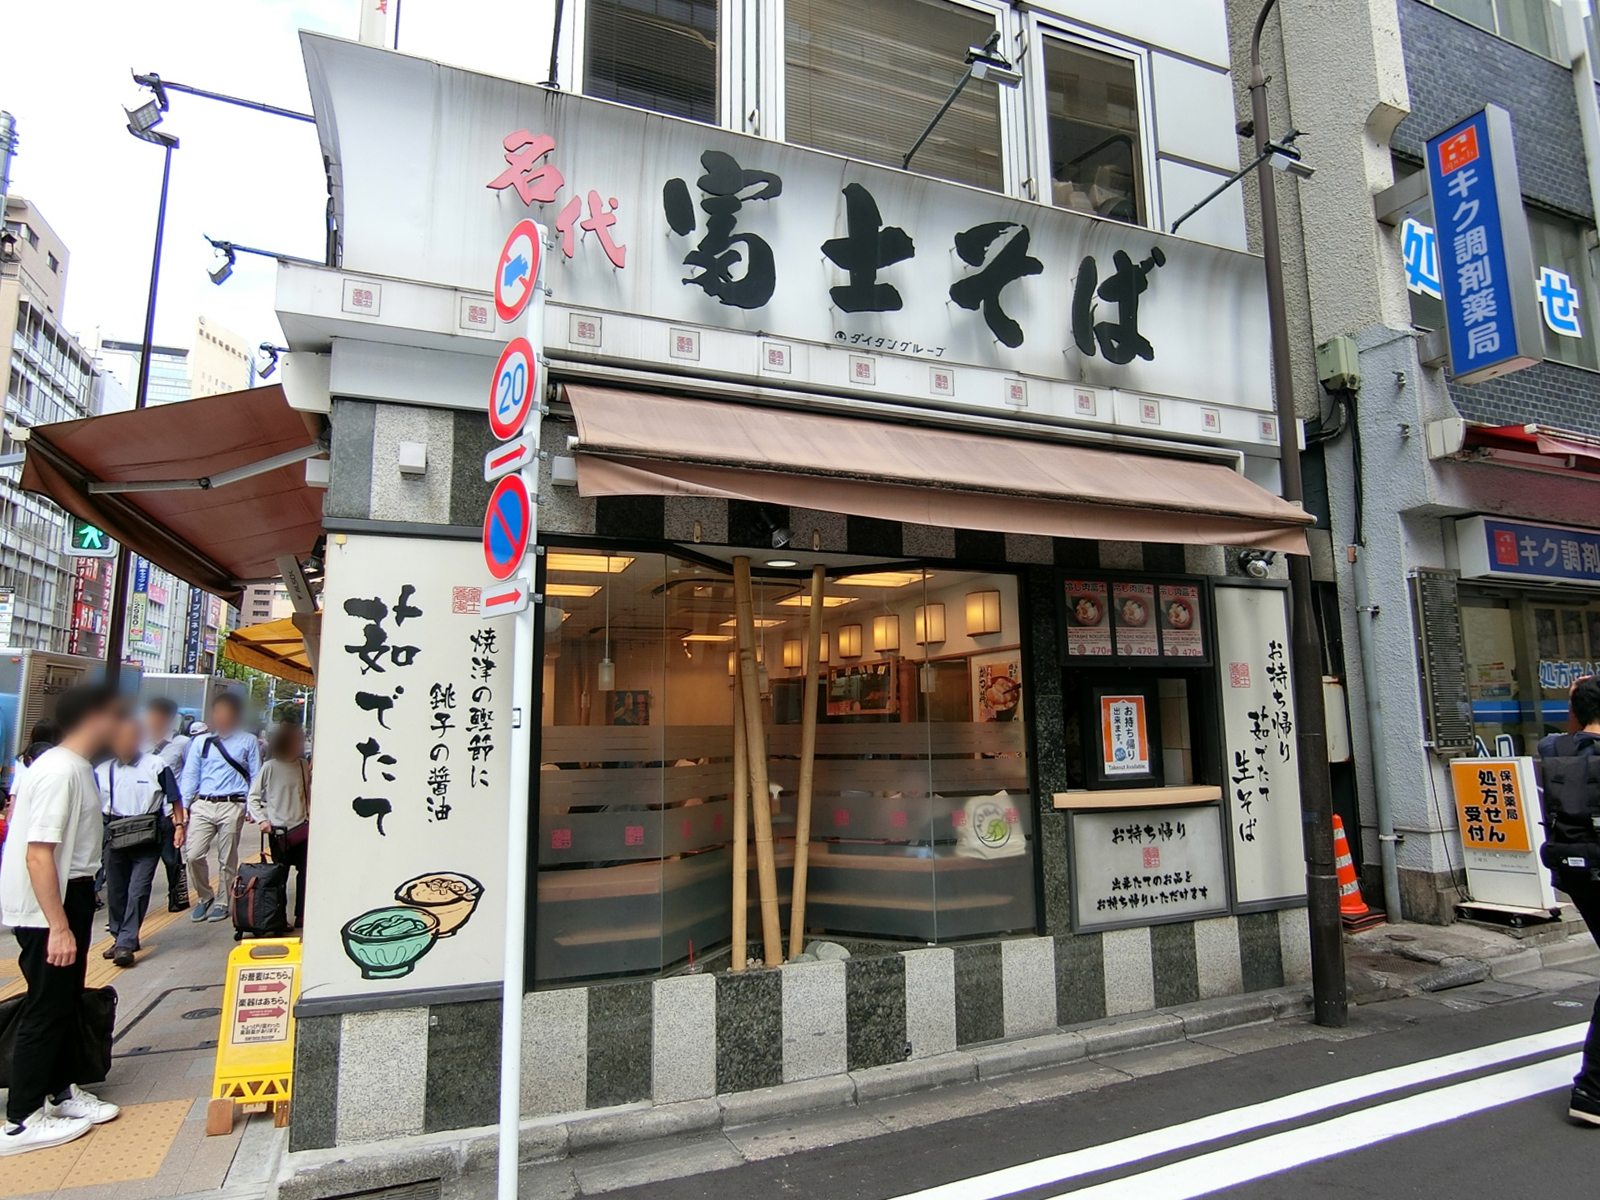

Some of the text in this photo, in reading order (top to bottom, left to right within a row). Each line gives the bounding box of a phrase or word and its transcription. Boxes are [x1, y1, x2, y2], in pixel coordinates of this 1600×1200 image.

[486, 129, 1166, 365] 名代 富士そば
[1447, 167, 1501, 361] キク調剤薬局
[850, 333, 947, 357] ダイタングループ
[498, 362, 525, 416] 20
[1519, 534, 1600, 574] キク調剤
[343, 584, 424, 837] 茹でたて
[465, 627, 500, 788] 焼津の鰹節に
[1124, 706, 1136, 761] お持ち帰り
[1266, 640, 1293, 763] お持ち帰り
[426, 682, 458, 823] 銚子の醤油
[1248, 705, 1271, 802] 茹でたて
[1232, 750, 1257, 842] 生そば
[1464, 806, 1485, 842] 受付
[1478, 769, 1506, 843] 処方せん
[1499, 770, 1519, 821] 保険薬局
[1111, 821, 1187, 845] お持ち帰り
[1096, 885, 1209, 912] お持ち帰りいただけます
[1111, 870, 1194, 892] 出来たてのお品を
